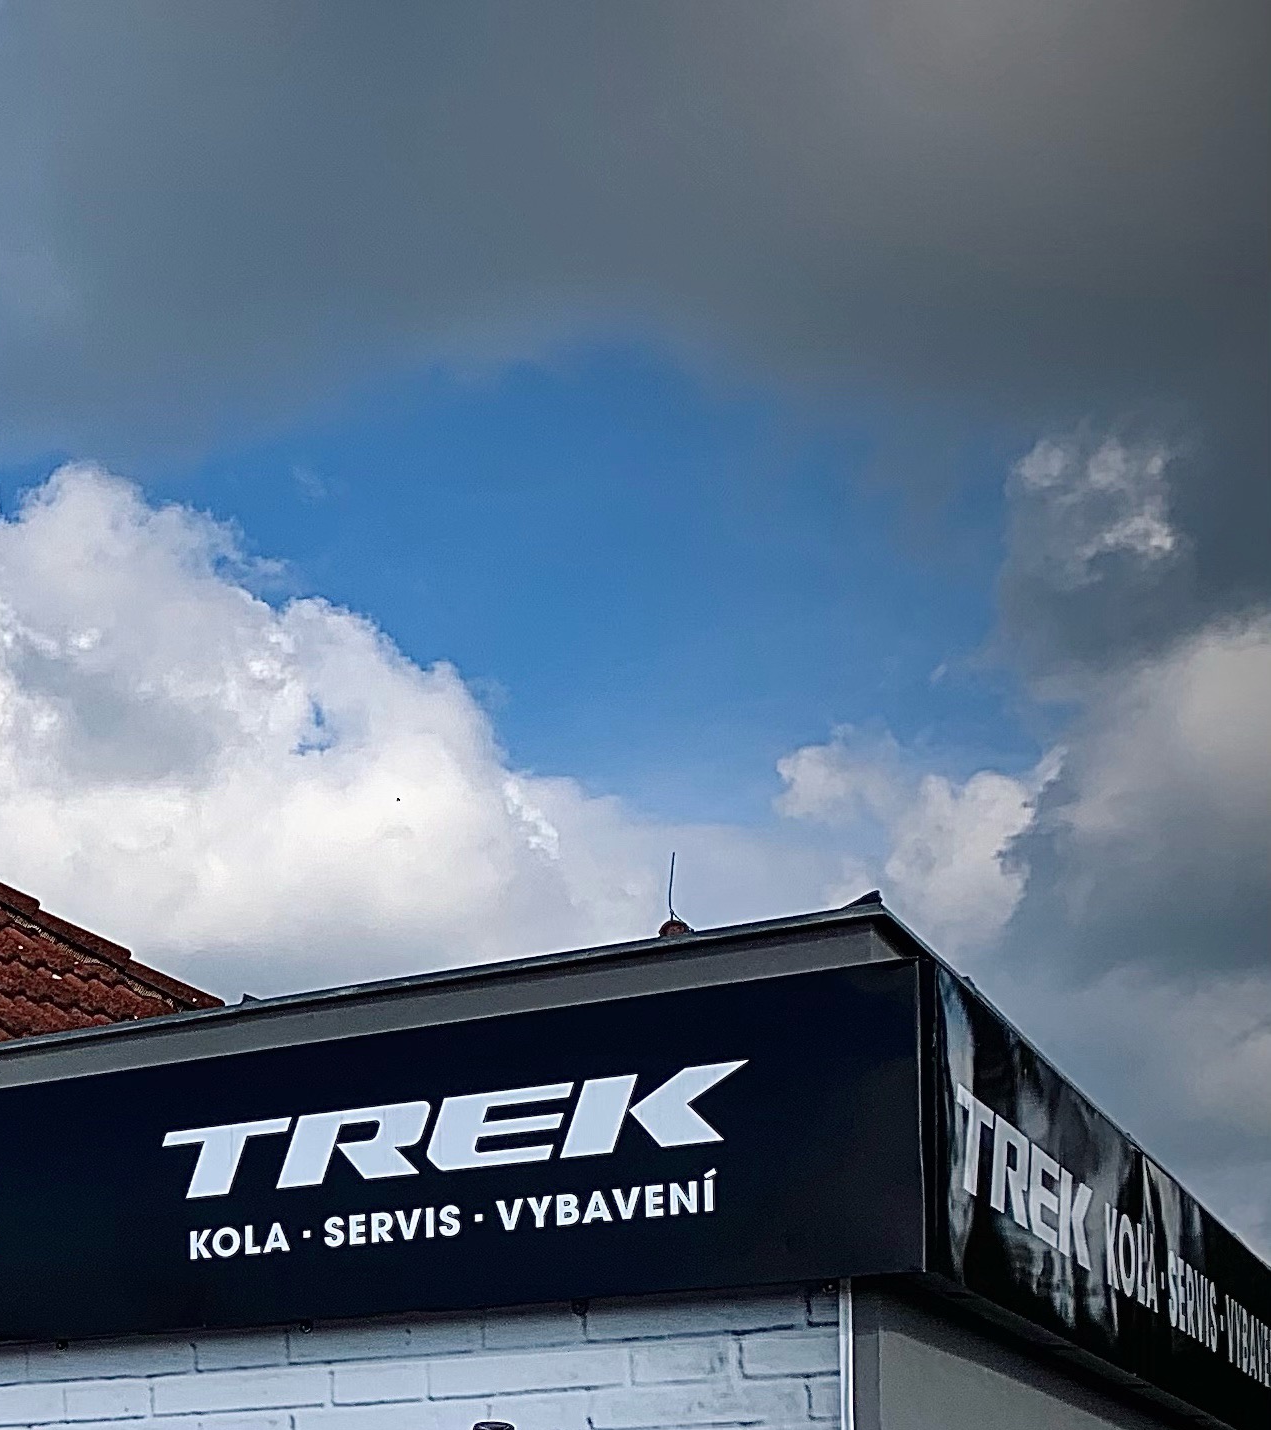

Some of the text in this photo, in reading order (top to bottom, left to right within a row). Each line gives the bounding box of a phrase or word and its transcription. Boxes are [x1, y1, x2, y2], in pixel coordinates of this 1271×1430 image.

[162, 1059, 749, 1199] TREK
[957, 1083, 1093, 1271] TREK
[189, 1168, 718, 1260] KOLA SERVIS VYBAVENÍ
[1105, 1202, 1271, 1388] KOLA SERVIS VYBAVE
